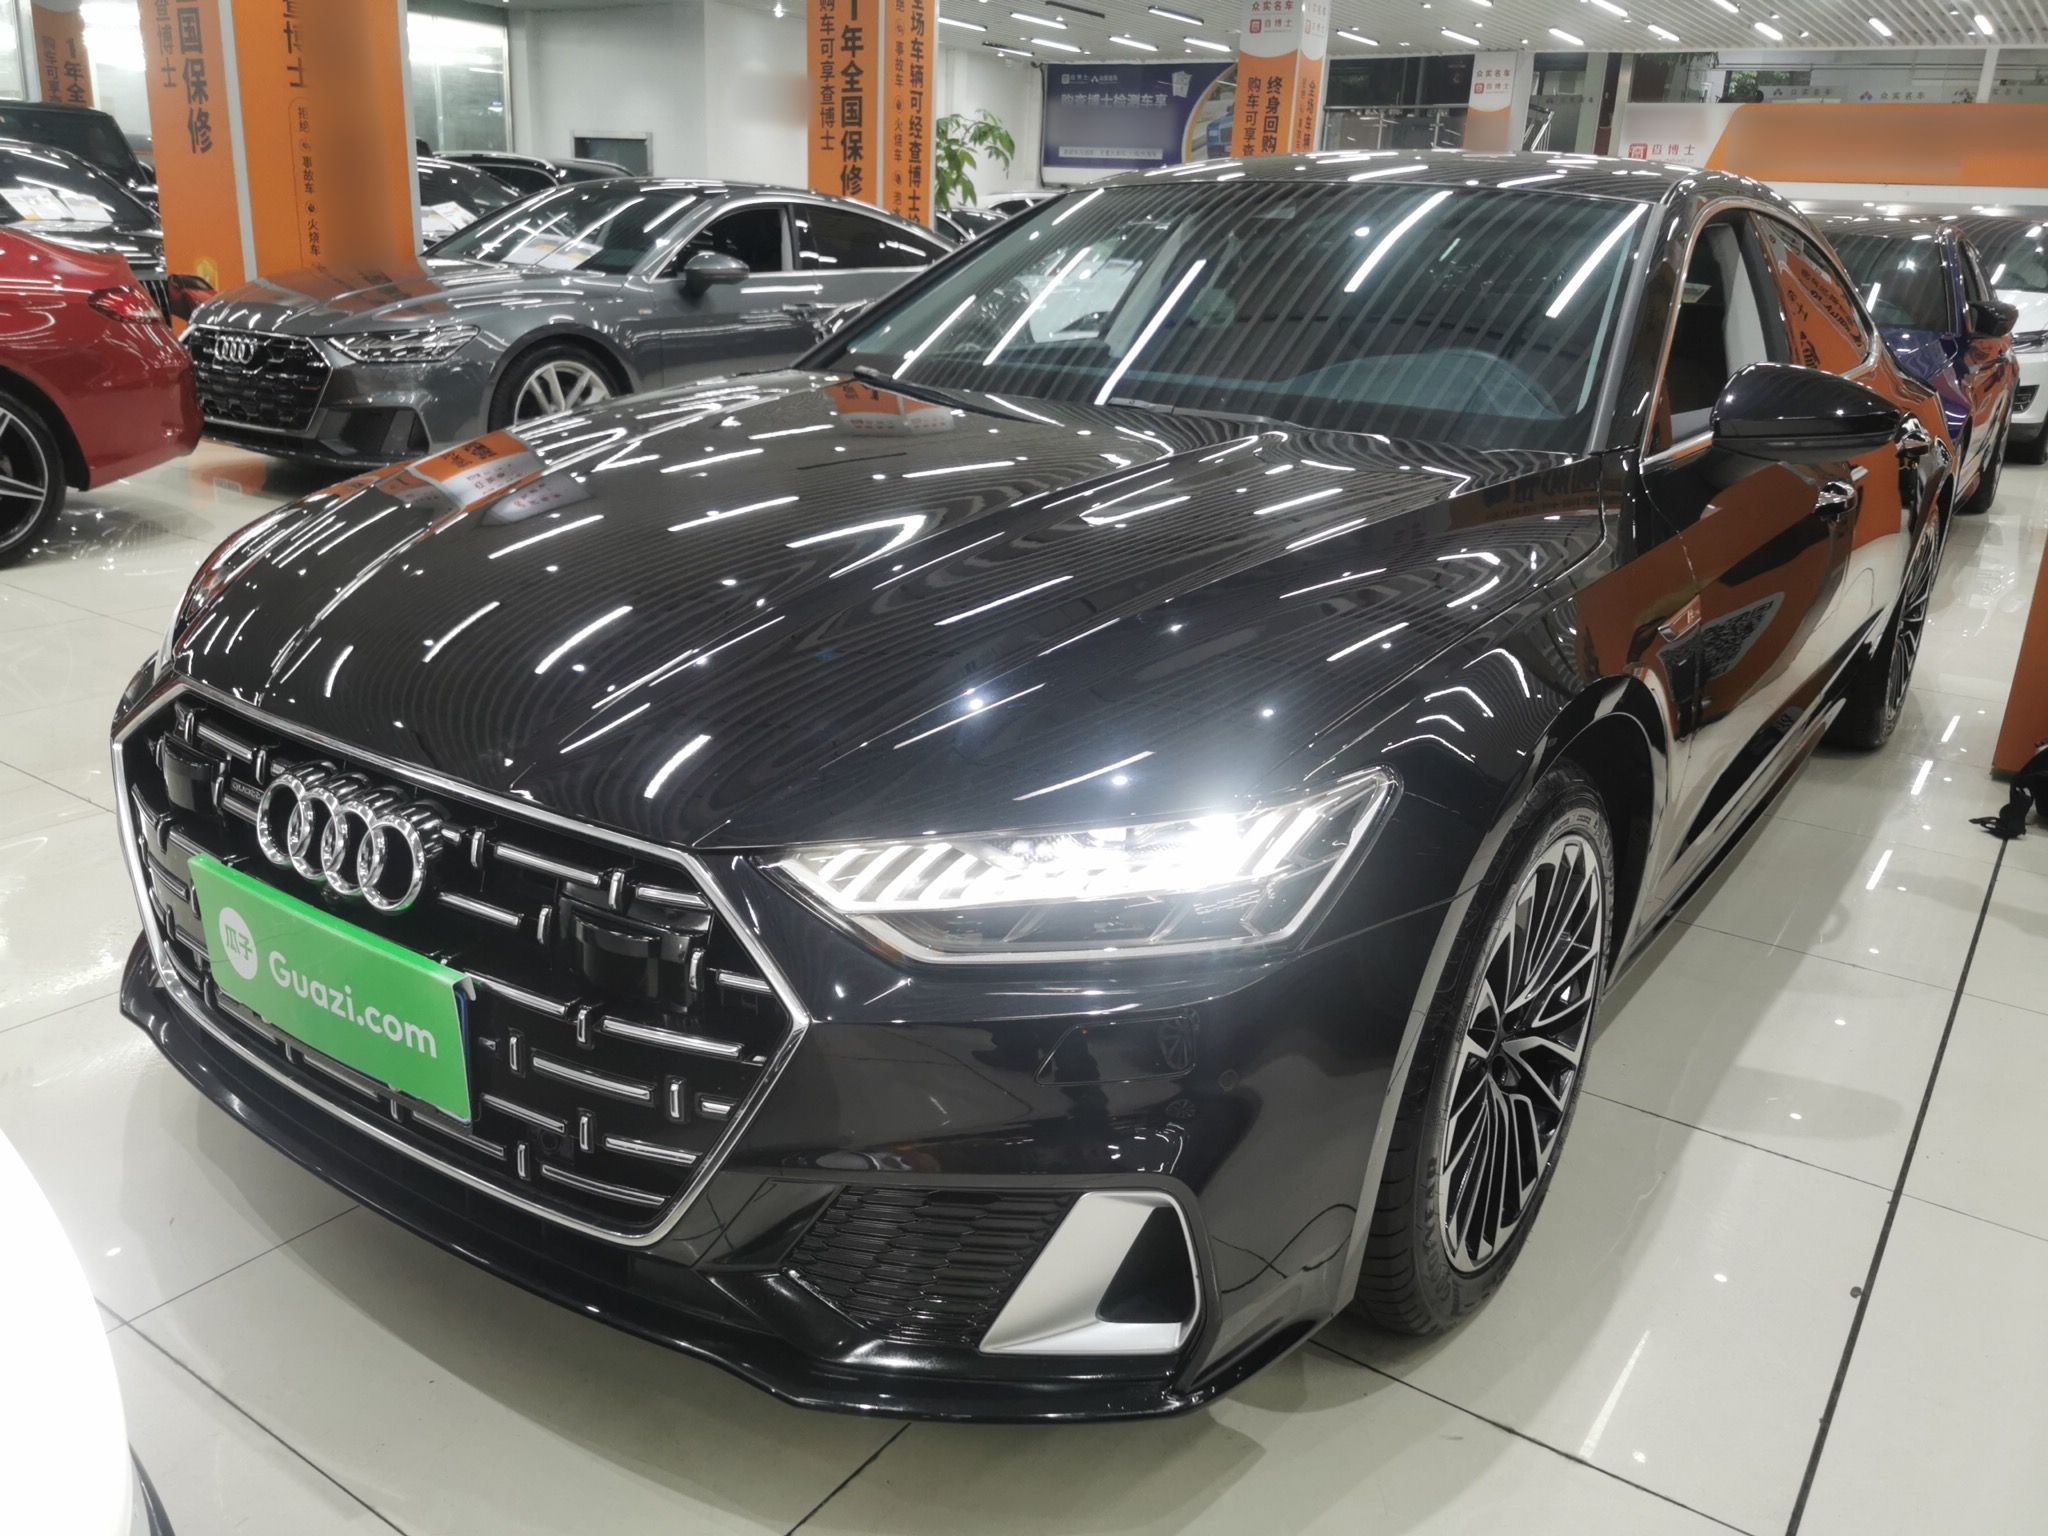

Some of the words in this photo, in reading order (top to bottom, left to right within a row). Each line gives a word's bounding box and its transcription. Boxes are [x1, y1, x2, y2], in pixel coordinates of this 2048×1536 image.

[176, 0, 213, 154] 国保修
[818, 0, 836, 151] 购车可享查博士
[1261, 76, 1283, 154] 终身回购
[225, 923, 254, 961] 瓜子
[268, 950, 438, 1059] Guazi.com
